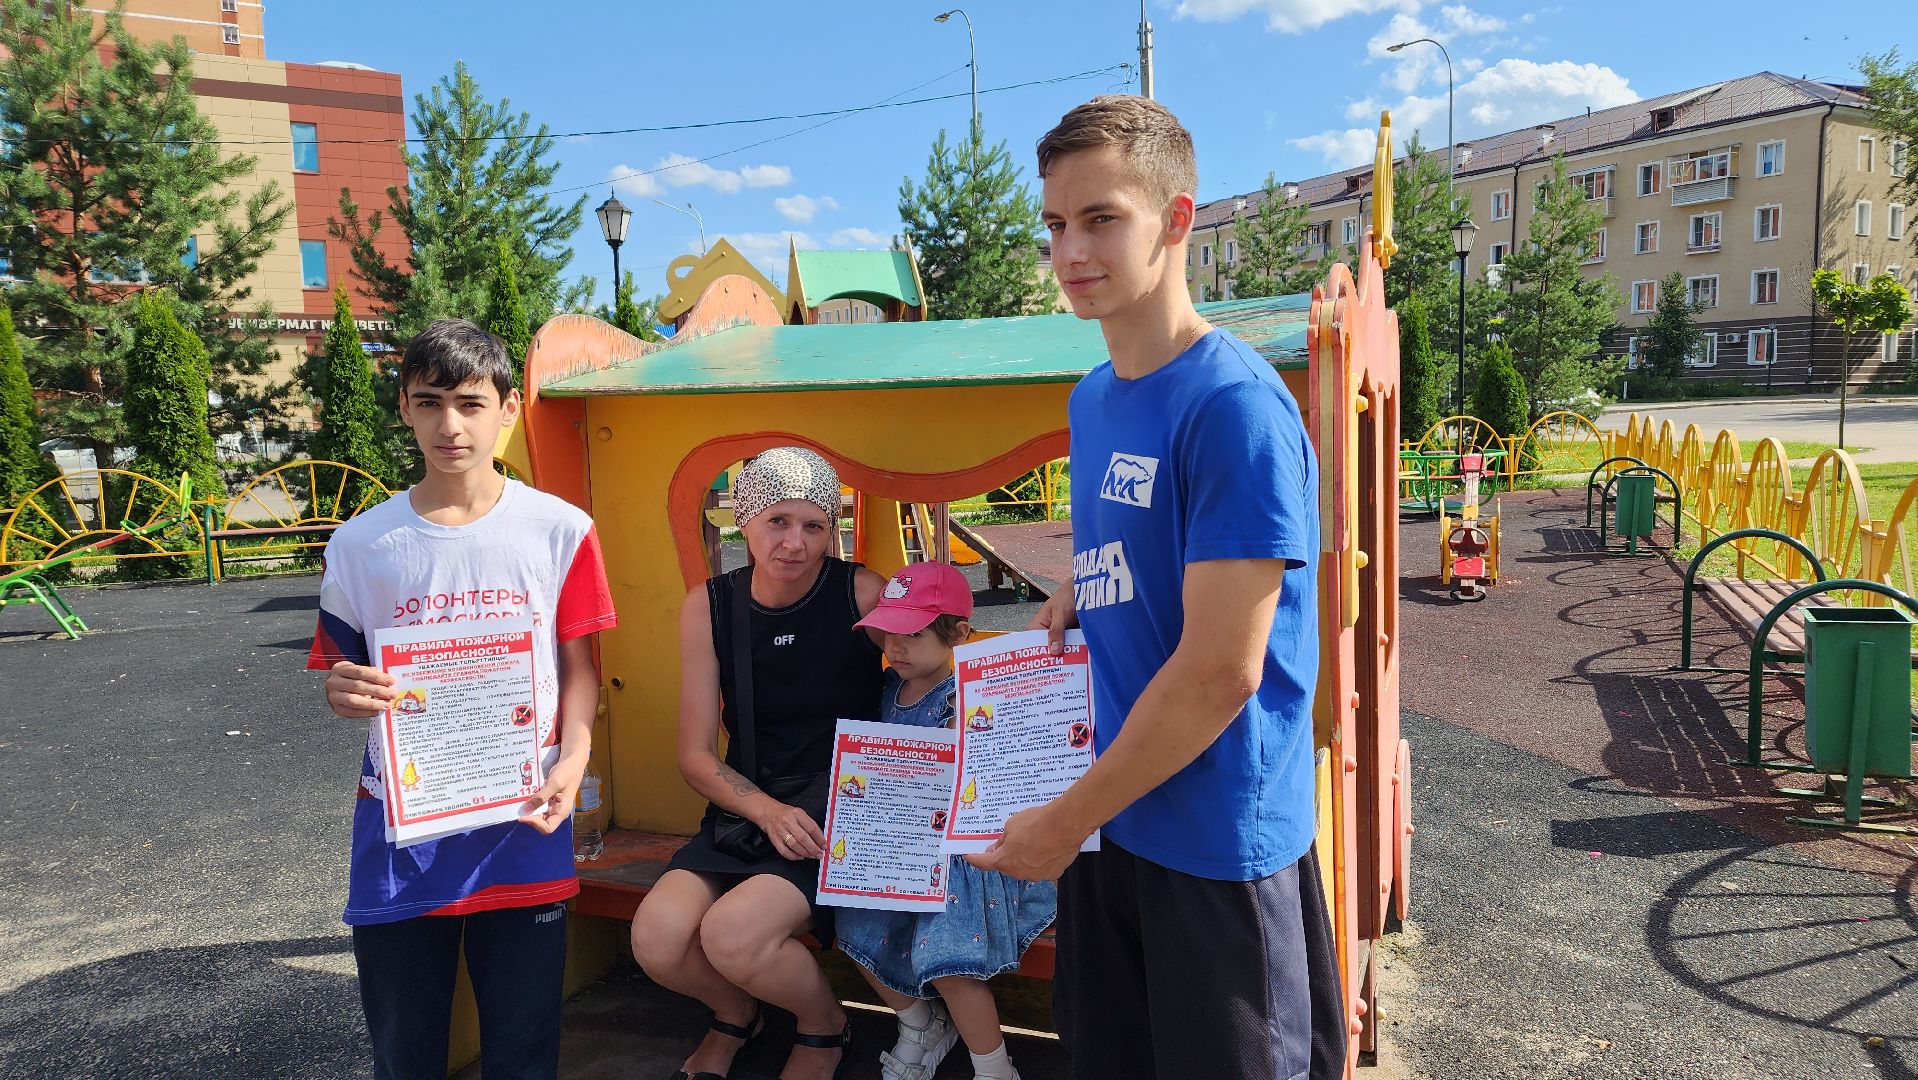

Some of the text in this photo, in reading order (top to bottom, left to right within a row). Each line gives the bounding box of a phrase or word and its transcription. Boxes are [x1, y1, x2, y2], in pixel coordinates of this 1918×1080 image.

[393, 631, 525, 653] ПРАВИЛА ПОЖАРНОЙ
[774, 634, 795, 646] OFF
[410, 644, 509, 664] БЕЗОПАСНОСТИ
[967, 645, 1080, 670] ПРАВИЛА ПОЖАОЙ
[981, 656, 1064, 679] БЕЗОПАСНОСТИ
[847, 735, 951, 751] ПРАВИЛА ПОЖАРНОЙ
[859, 745, 937, 760] БЕЗОПАСНОСТИ
[472, 794, 486, 805] 01
[519, 784, 537, 796] 112
[926, 888, 943, 896] 112
